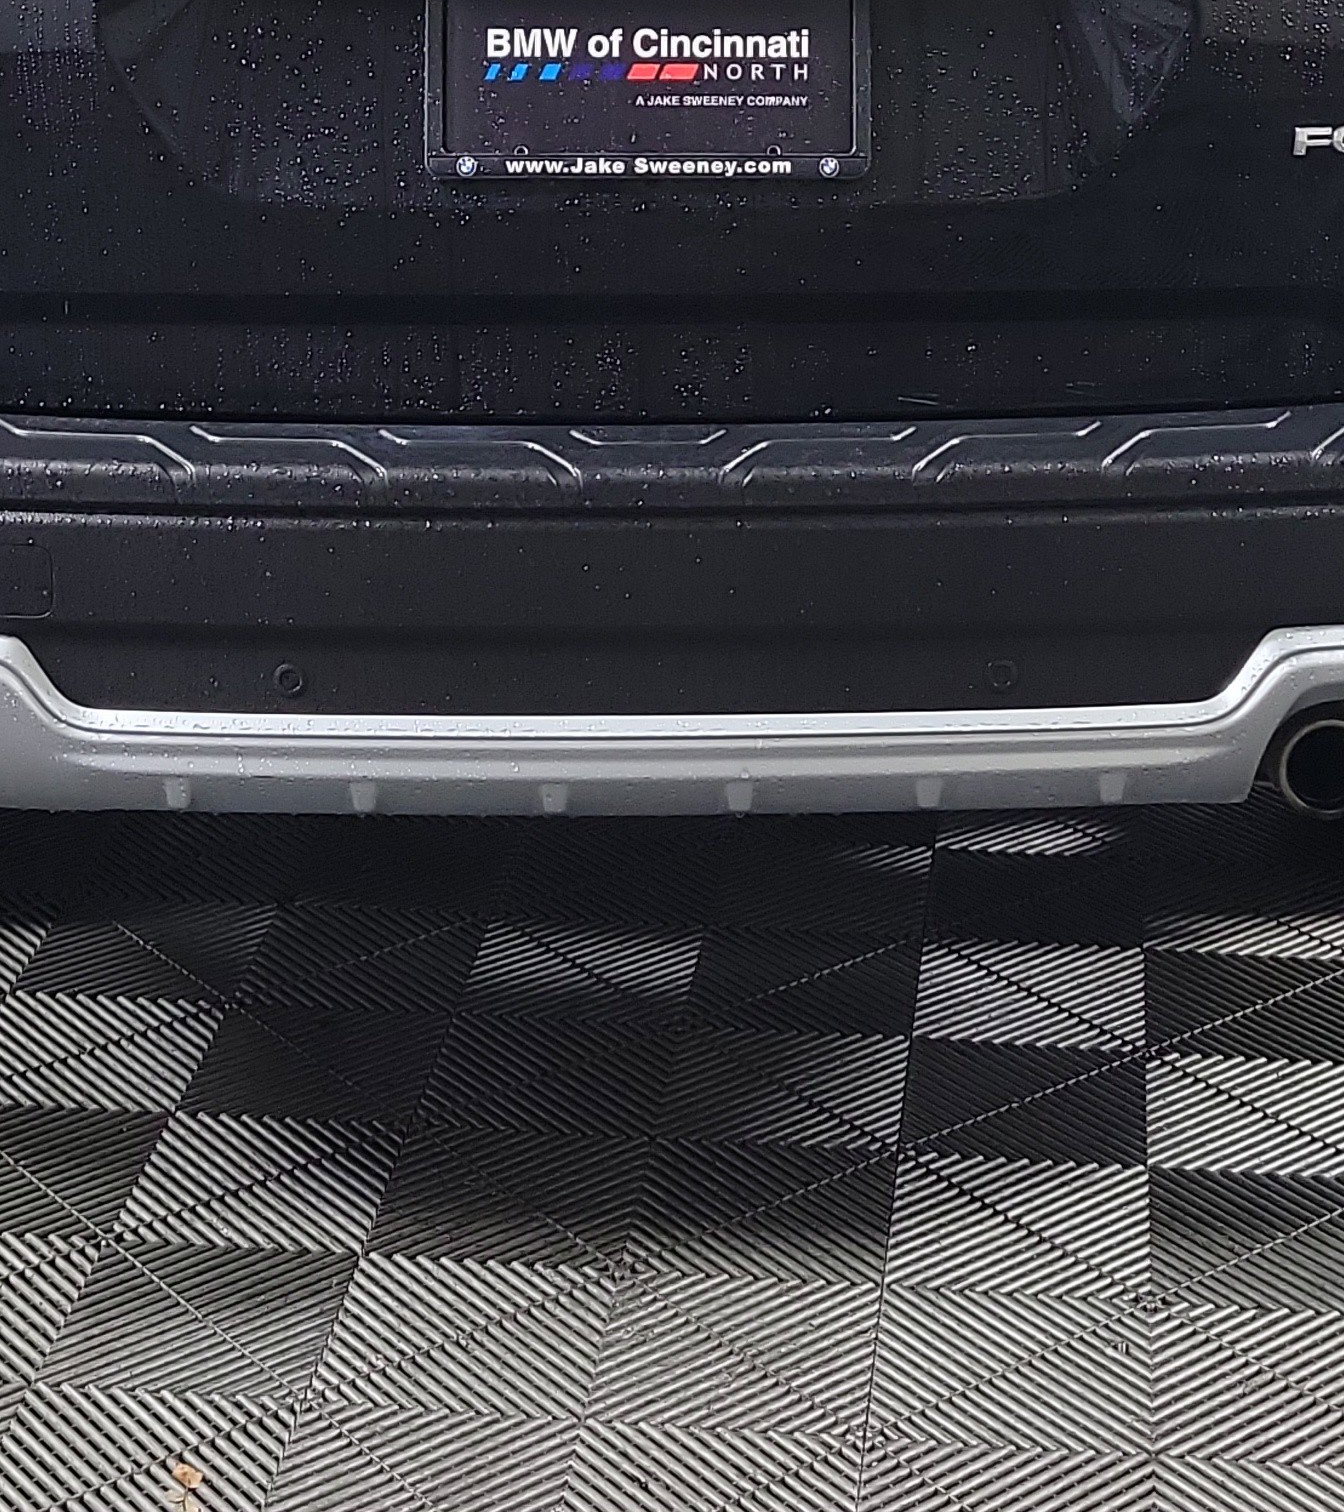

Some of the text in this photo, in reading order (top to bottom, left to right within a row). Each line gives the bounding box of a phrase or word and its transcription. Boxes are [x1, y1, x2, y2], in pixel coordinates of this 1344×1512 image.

[486, 27, 810, 58] BMW of Cincinnati
[702, 63, 809, 81] NORTH
[635, 95, 808, 107] A JAKE SWEENEY COMPANY
[505, 158, 792, 177] www.Jake Sweeney.com
